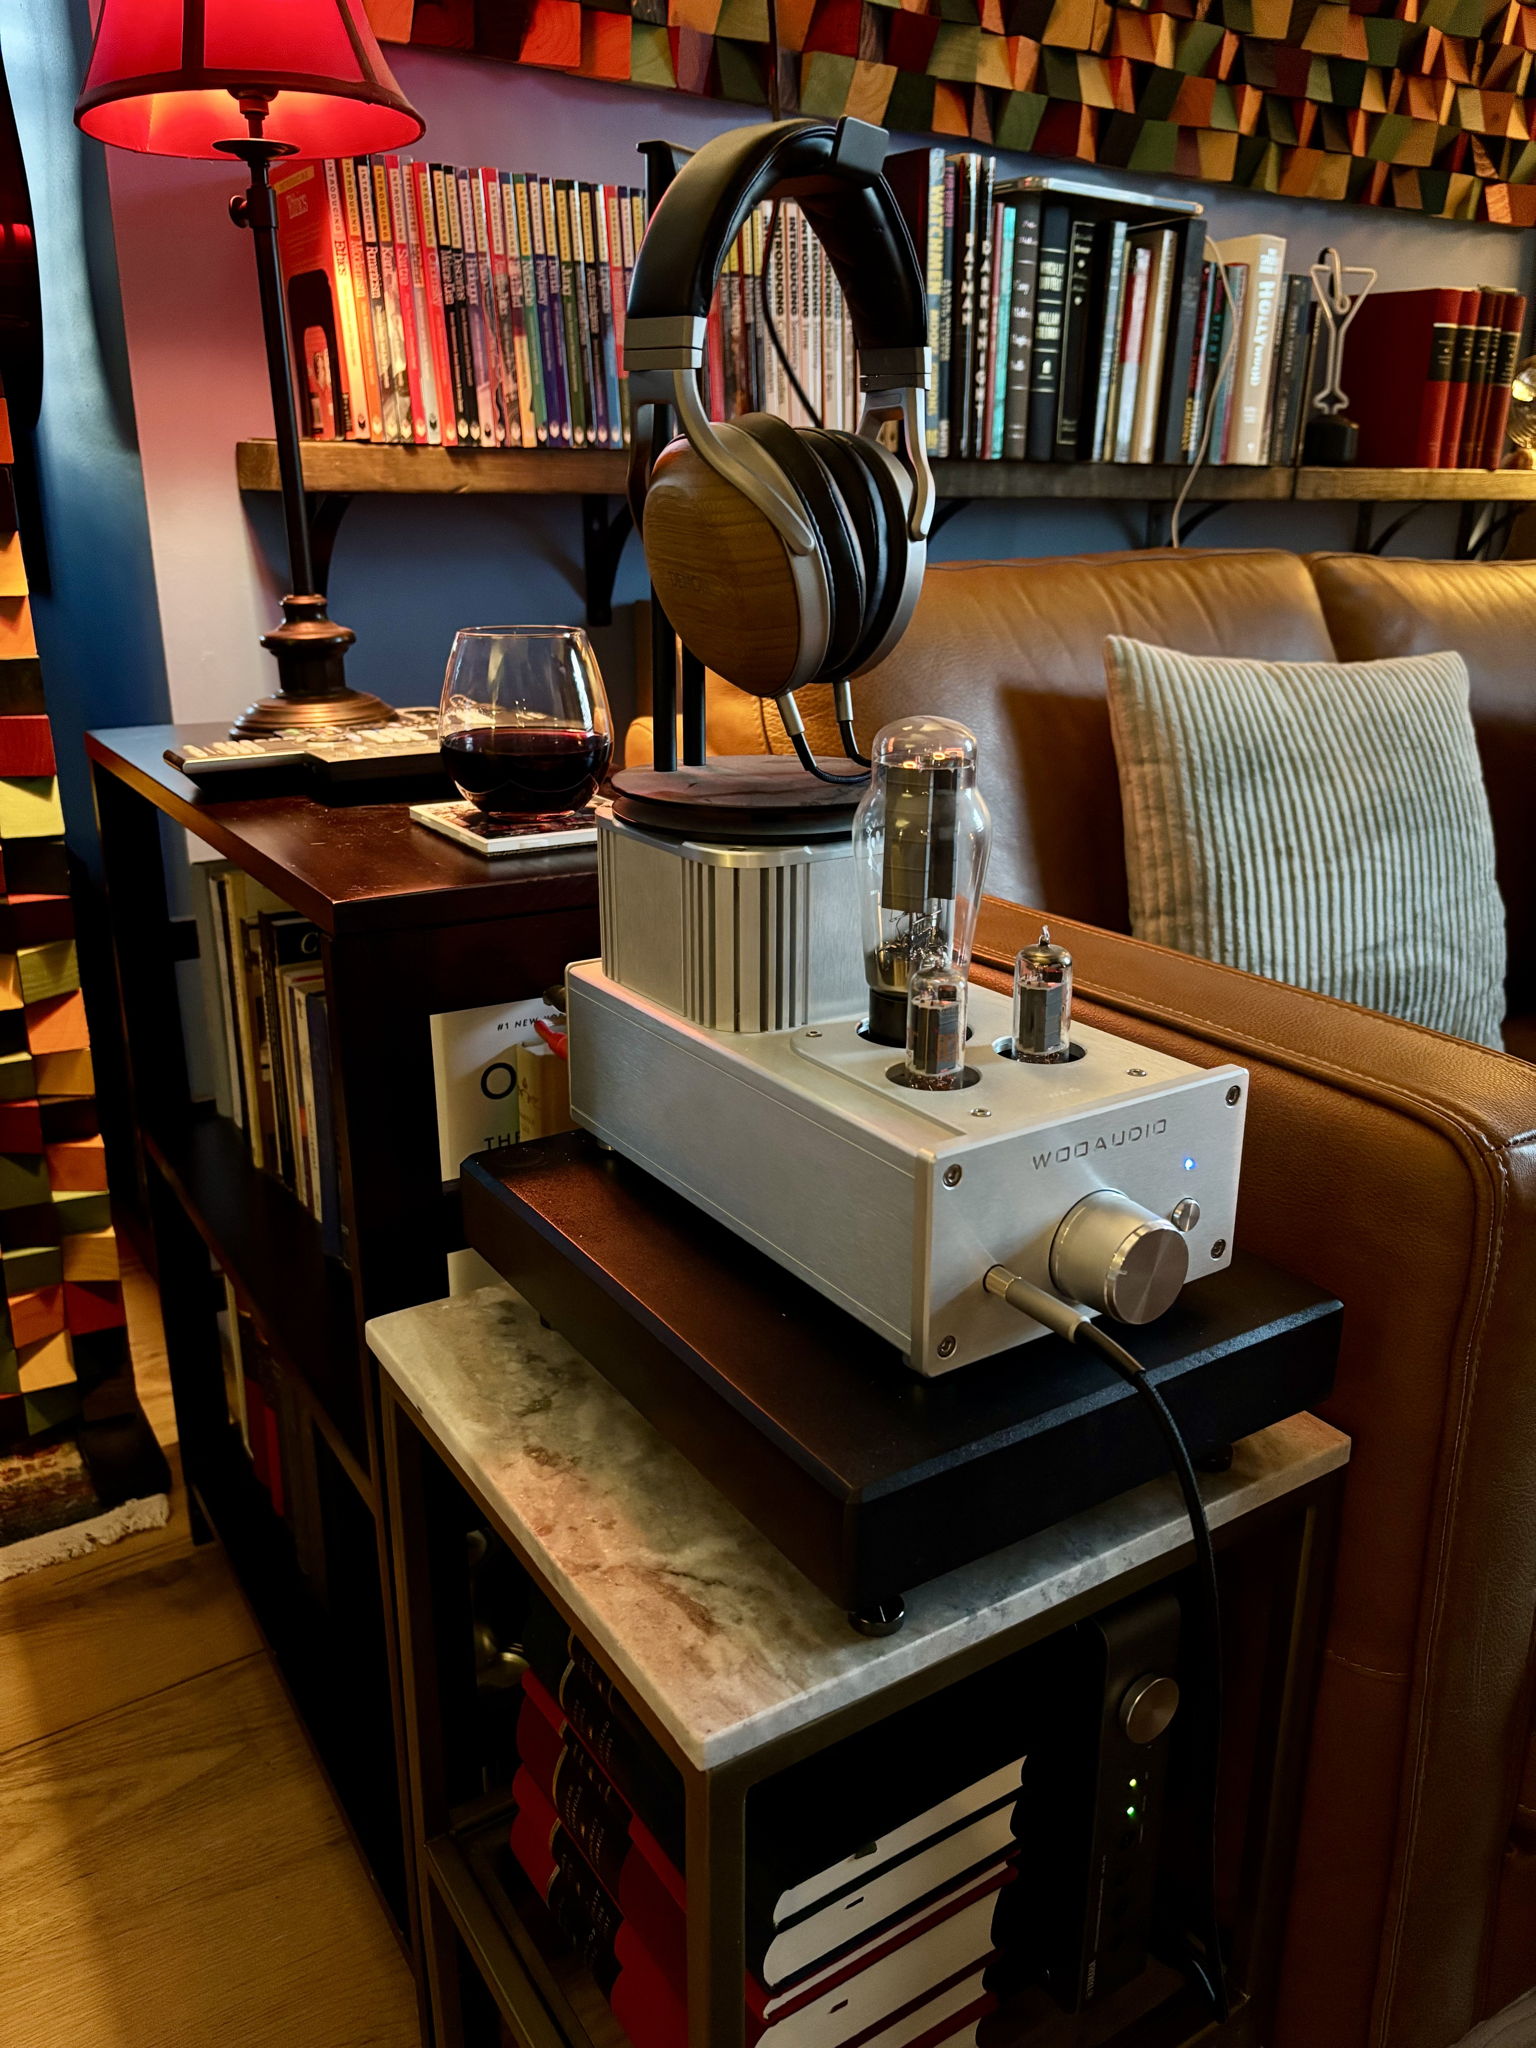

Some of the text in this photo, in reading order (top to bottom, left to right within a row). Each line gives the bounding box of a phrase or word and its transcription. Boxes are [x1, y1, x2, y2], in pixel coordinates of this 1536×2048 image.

[327, 161, 347, 276] INTRODUCING Ethics
[345, 161, 358, 232] INTRODUCING
[360, 168, 373, 239] INTRODUCING
[376, 167, 389, 238] INTRODUCING
[392, 170, 403, 240] INTRODUCING
[421, 174, 434, 244] INTRODUCING
[436, 172, 447, 242] INTRODUCING
[448, 177, 459, 245] INTRODUCING
[774, 217, 784, 316] INTRODUCING
[789, 216, 798, 316] INTRODUCING
[801, 219, 809, 318] INTRODUCING
[812, 232, 820, 316] TRODUCING
[927, 185, 945, 294] WATCHMEN
[962, 232, 975, 325] BATMAN
[975, 240, 991, 418] DARK KNIGHT
[1250, 281, 1276, 387] HOLLYWOOD
[497, 1017, 539, 1031] #1 NEW
[1032, 1118, 1167, 1171] WOOAUDIO
